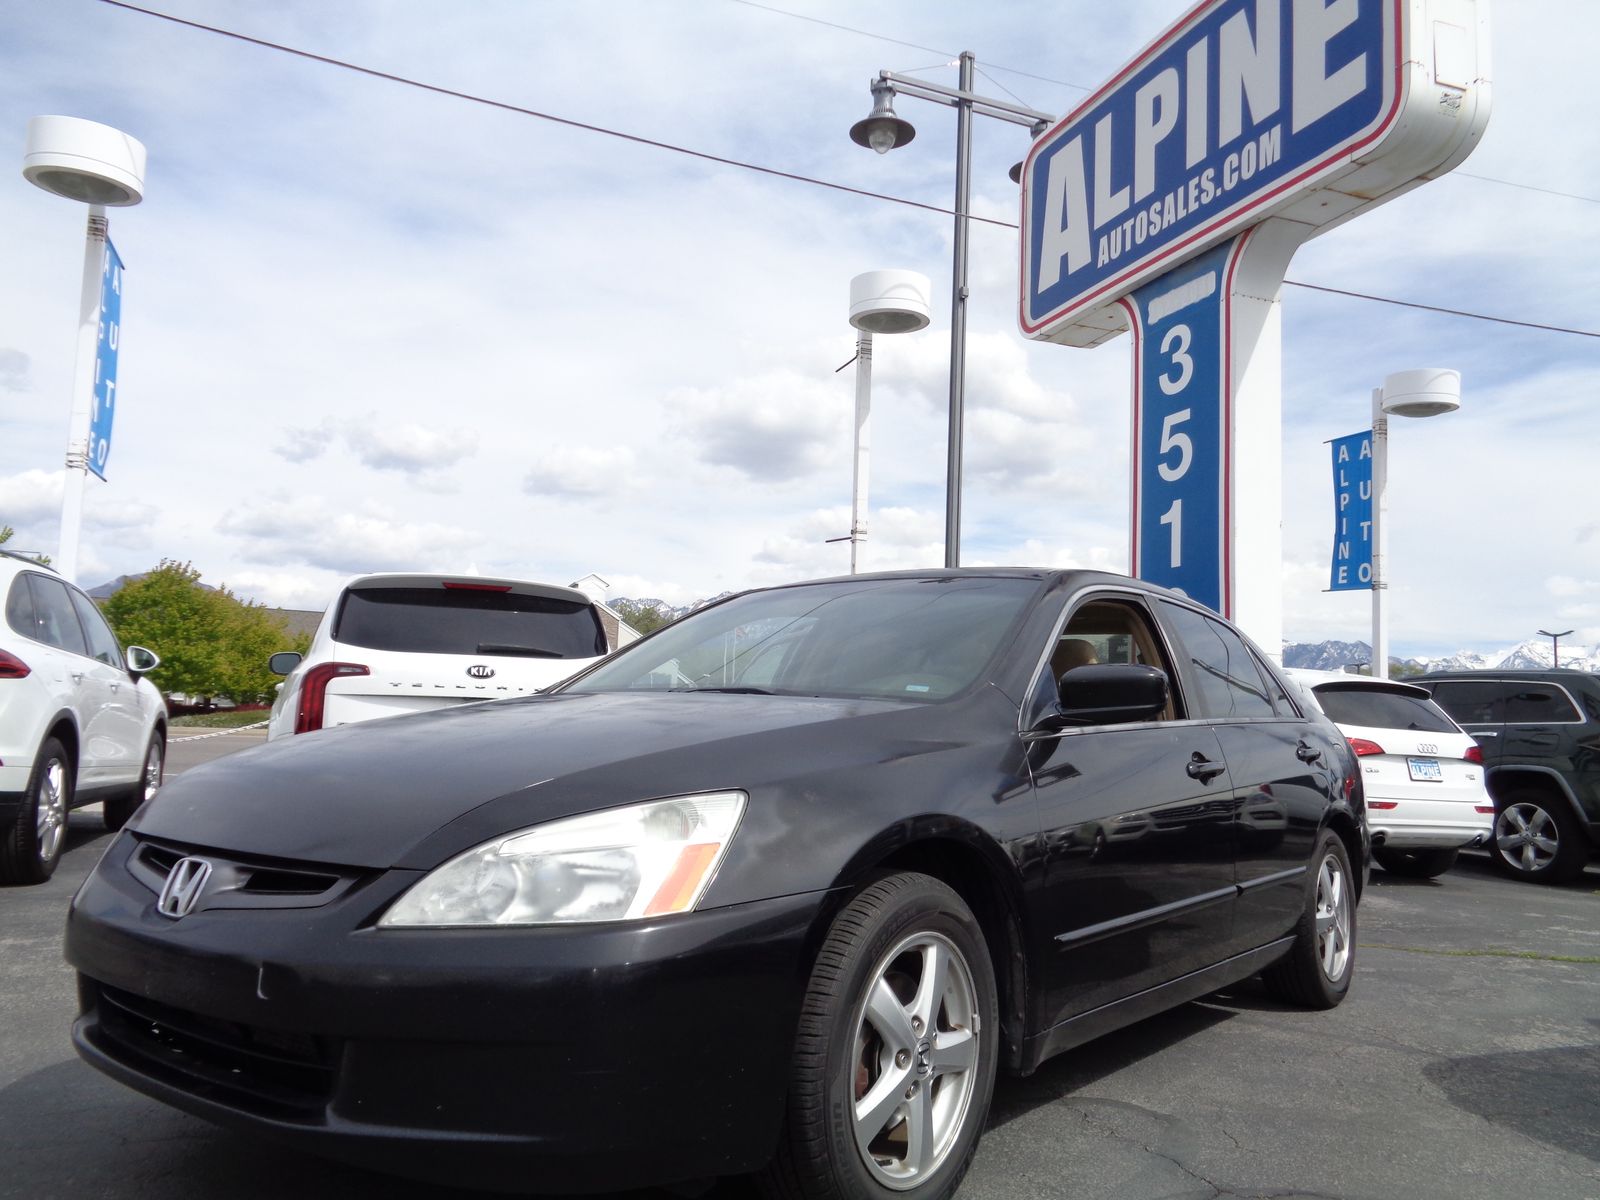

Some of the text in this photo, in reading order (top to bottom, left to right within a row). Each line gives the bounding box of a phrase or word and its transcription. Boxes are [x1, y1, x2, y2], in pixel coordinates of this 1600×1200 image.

[1038, 0, 1366, 295] ALPINE
[1097, 123, 1281, 269] AUTOSALES.COM
[97, 265, 121, 466] AUTO
[1157, 323, 1194, 599] 351
[1338, 445, 1350, 583] ALPINE
[1358, 440, 1372, 583] AUTO
[1411, 765, 1441, 776] ALPINE
